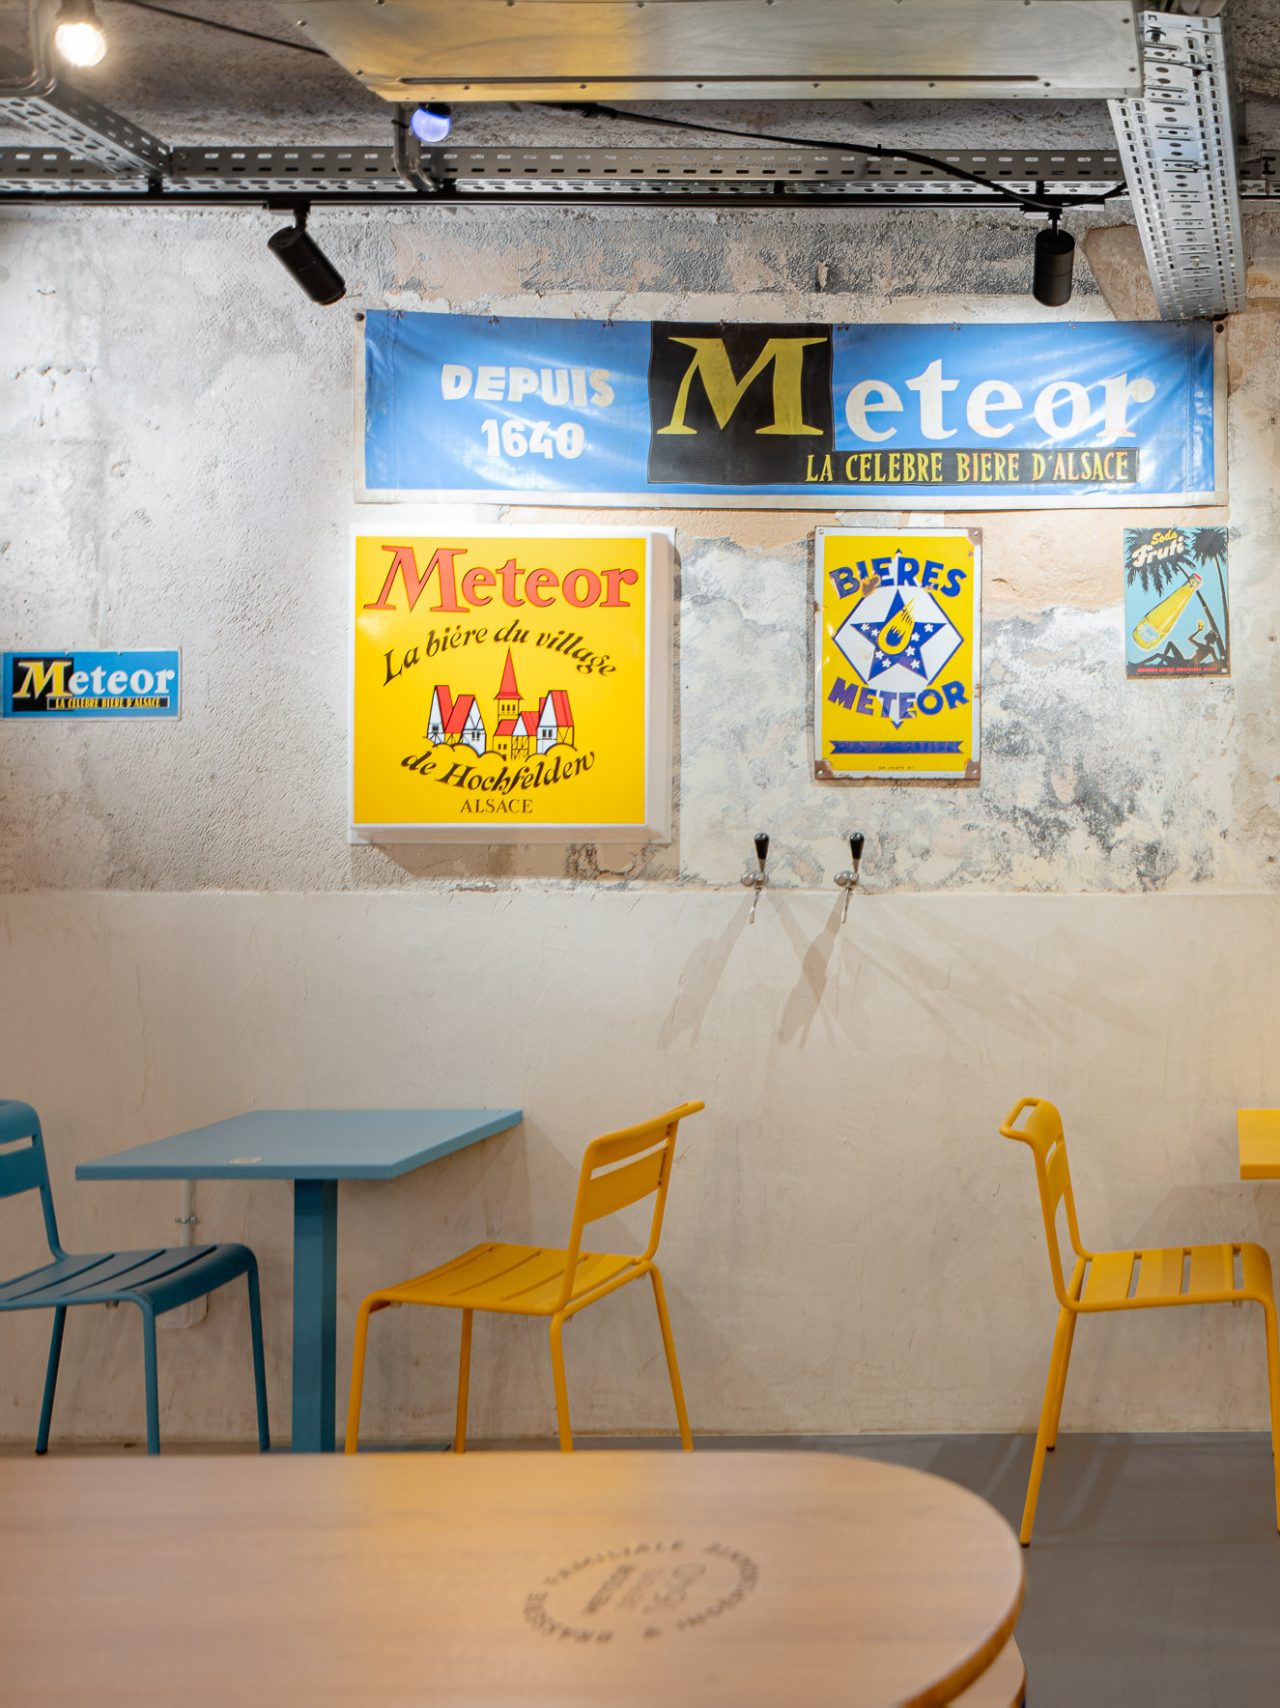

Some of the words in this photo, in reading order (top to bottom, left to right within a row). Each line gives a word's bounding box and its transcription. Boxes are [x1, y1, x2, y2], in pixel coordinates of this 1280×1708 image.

[442, 363, 614, 408] DEPUIS
[657, 336, 1156, 443] Meteor
[481, 418, 584, 460] 1640
[806, 454, 836, 483] LA
[845, 453, 943, 483] CELEBRE
[956, 453, 1020, 482] BIERE
[1032, 452, 1130, 482] D'ALSACE
[1151, 530, 1179, 546] Soda
[363, 545, 638, 613] Meteor
[828, 557, 968, 600] BIERES
[382, 647, 420, 687] La
[493, 619, 529, 643] du
[536, 630, 617, 678] village
[12, 659, 175, 699] Meteor
[828, 677, 970, 720] METEOR
[55, 697, 65, 708] LA
[400, 750, 437, 776] de
[435, 750, 595, 796] Hochfelden
[460, 799, 533, 814] ALSACE
